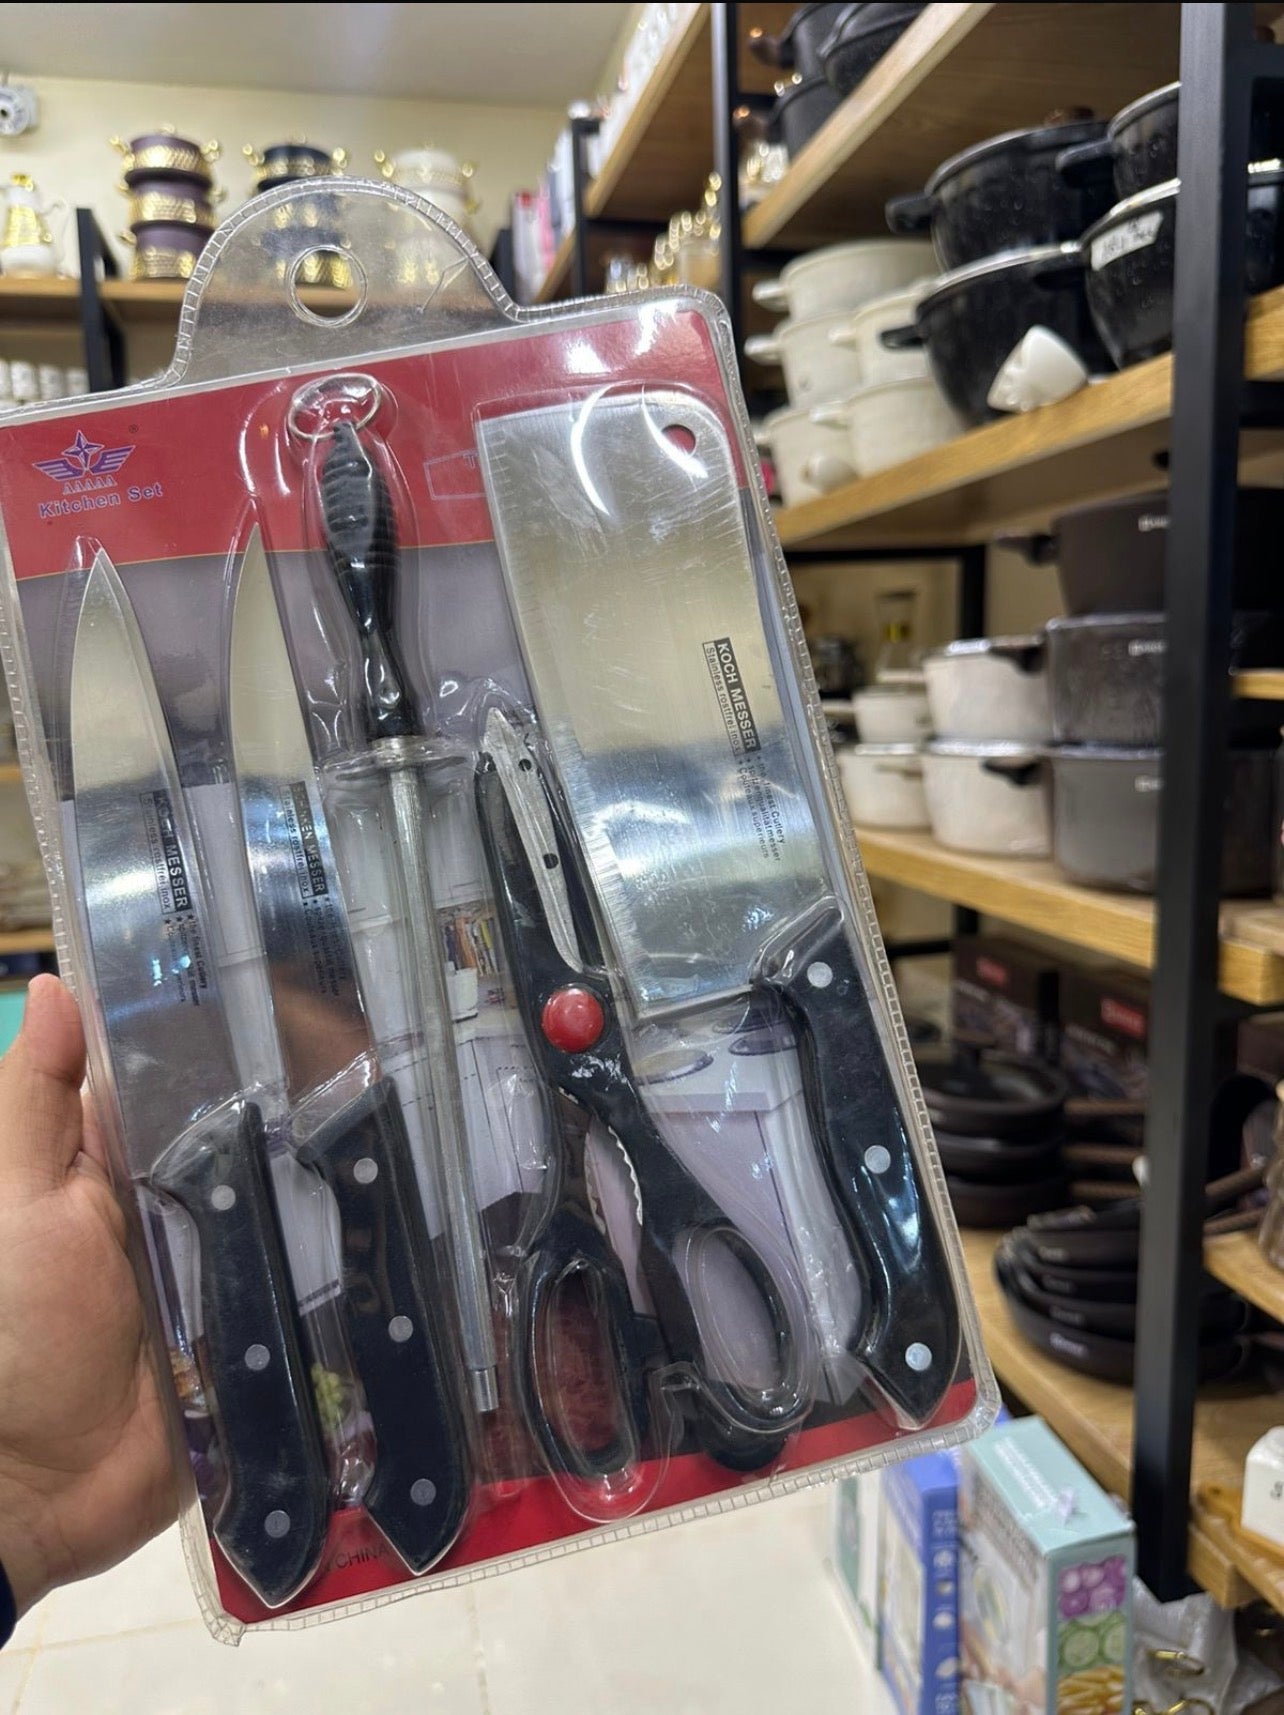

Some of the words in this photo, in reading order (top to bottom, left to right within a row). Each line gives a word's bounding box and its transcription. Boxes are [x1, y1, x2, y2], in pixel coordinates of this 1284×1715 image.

[39, 493, 121, 519] Kitchen
[127, 482, 163, 502] Set
[706, 646, 725, 691] Stainless
[717, 642, 737, 683] KOCH
[730, 688, 758, 749] MESSER
[771, 810, 786, 845] Cutlery
[165, 843, 189, 908] MESSER
[300, 871, 310, 893] inox
[307, 843, 326, 891] MESSER
[161, 887, 172, 910] inox
